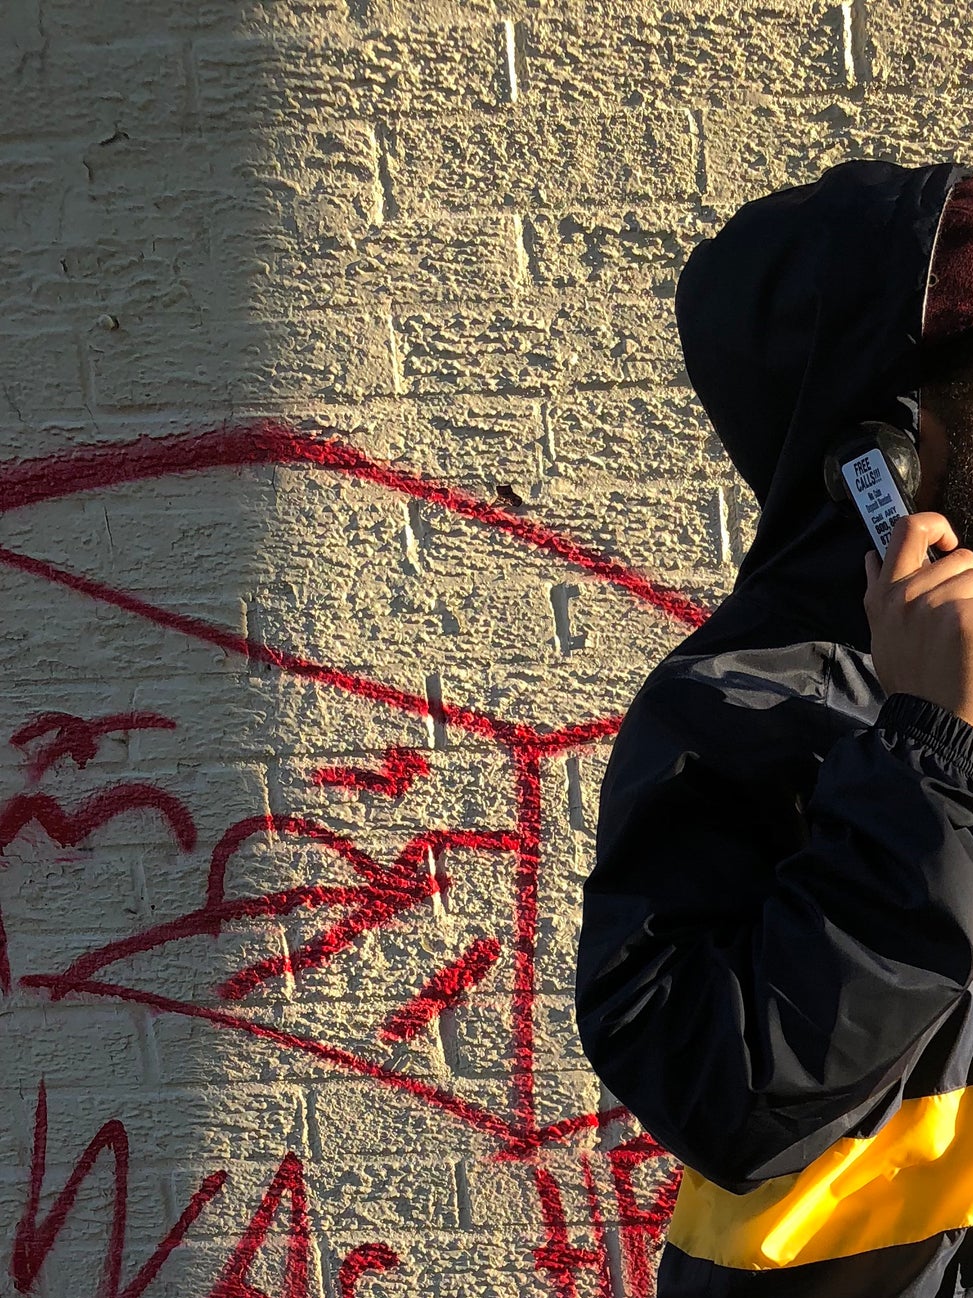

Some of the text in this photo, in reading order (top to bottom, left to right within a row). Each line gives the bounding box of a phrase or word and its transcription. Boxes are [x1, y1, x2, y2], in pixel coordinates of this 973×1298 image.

[854, 457, 871, 476] FREE
[872, 506, 897, 524] Call ANY
[875, 521, 891, 535] 800,
